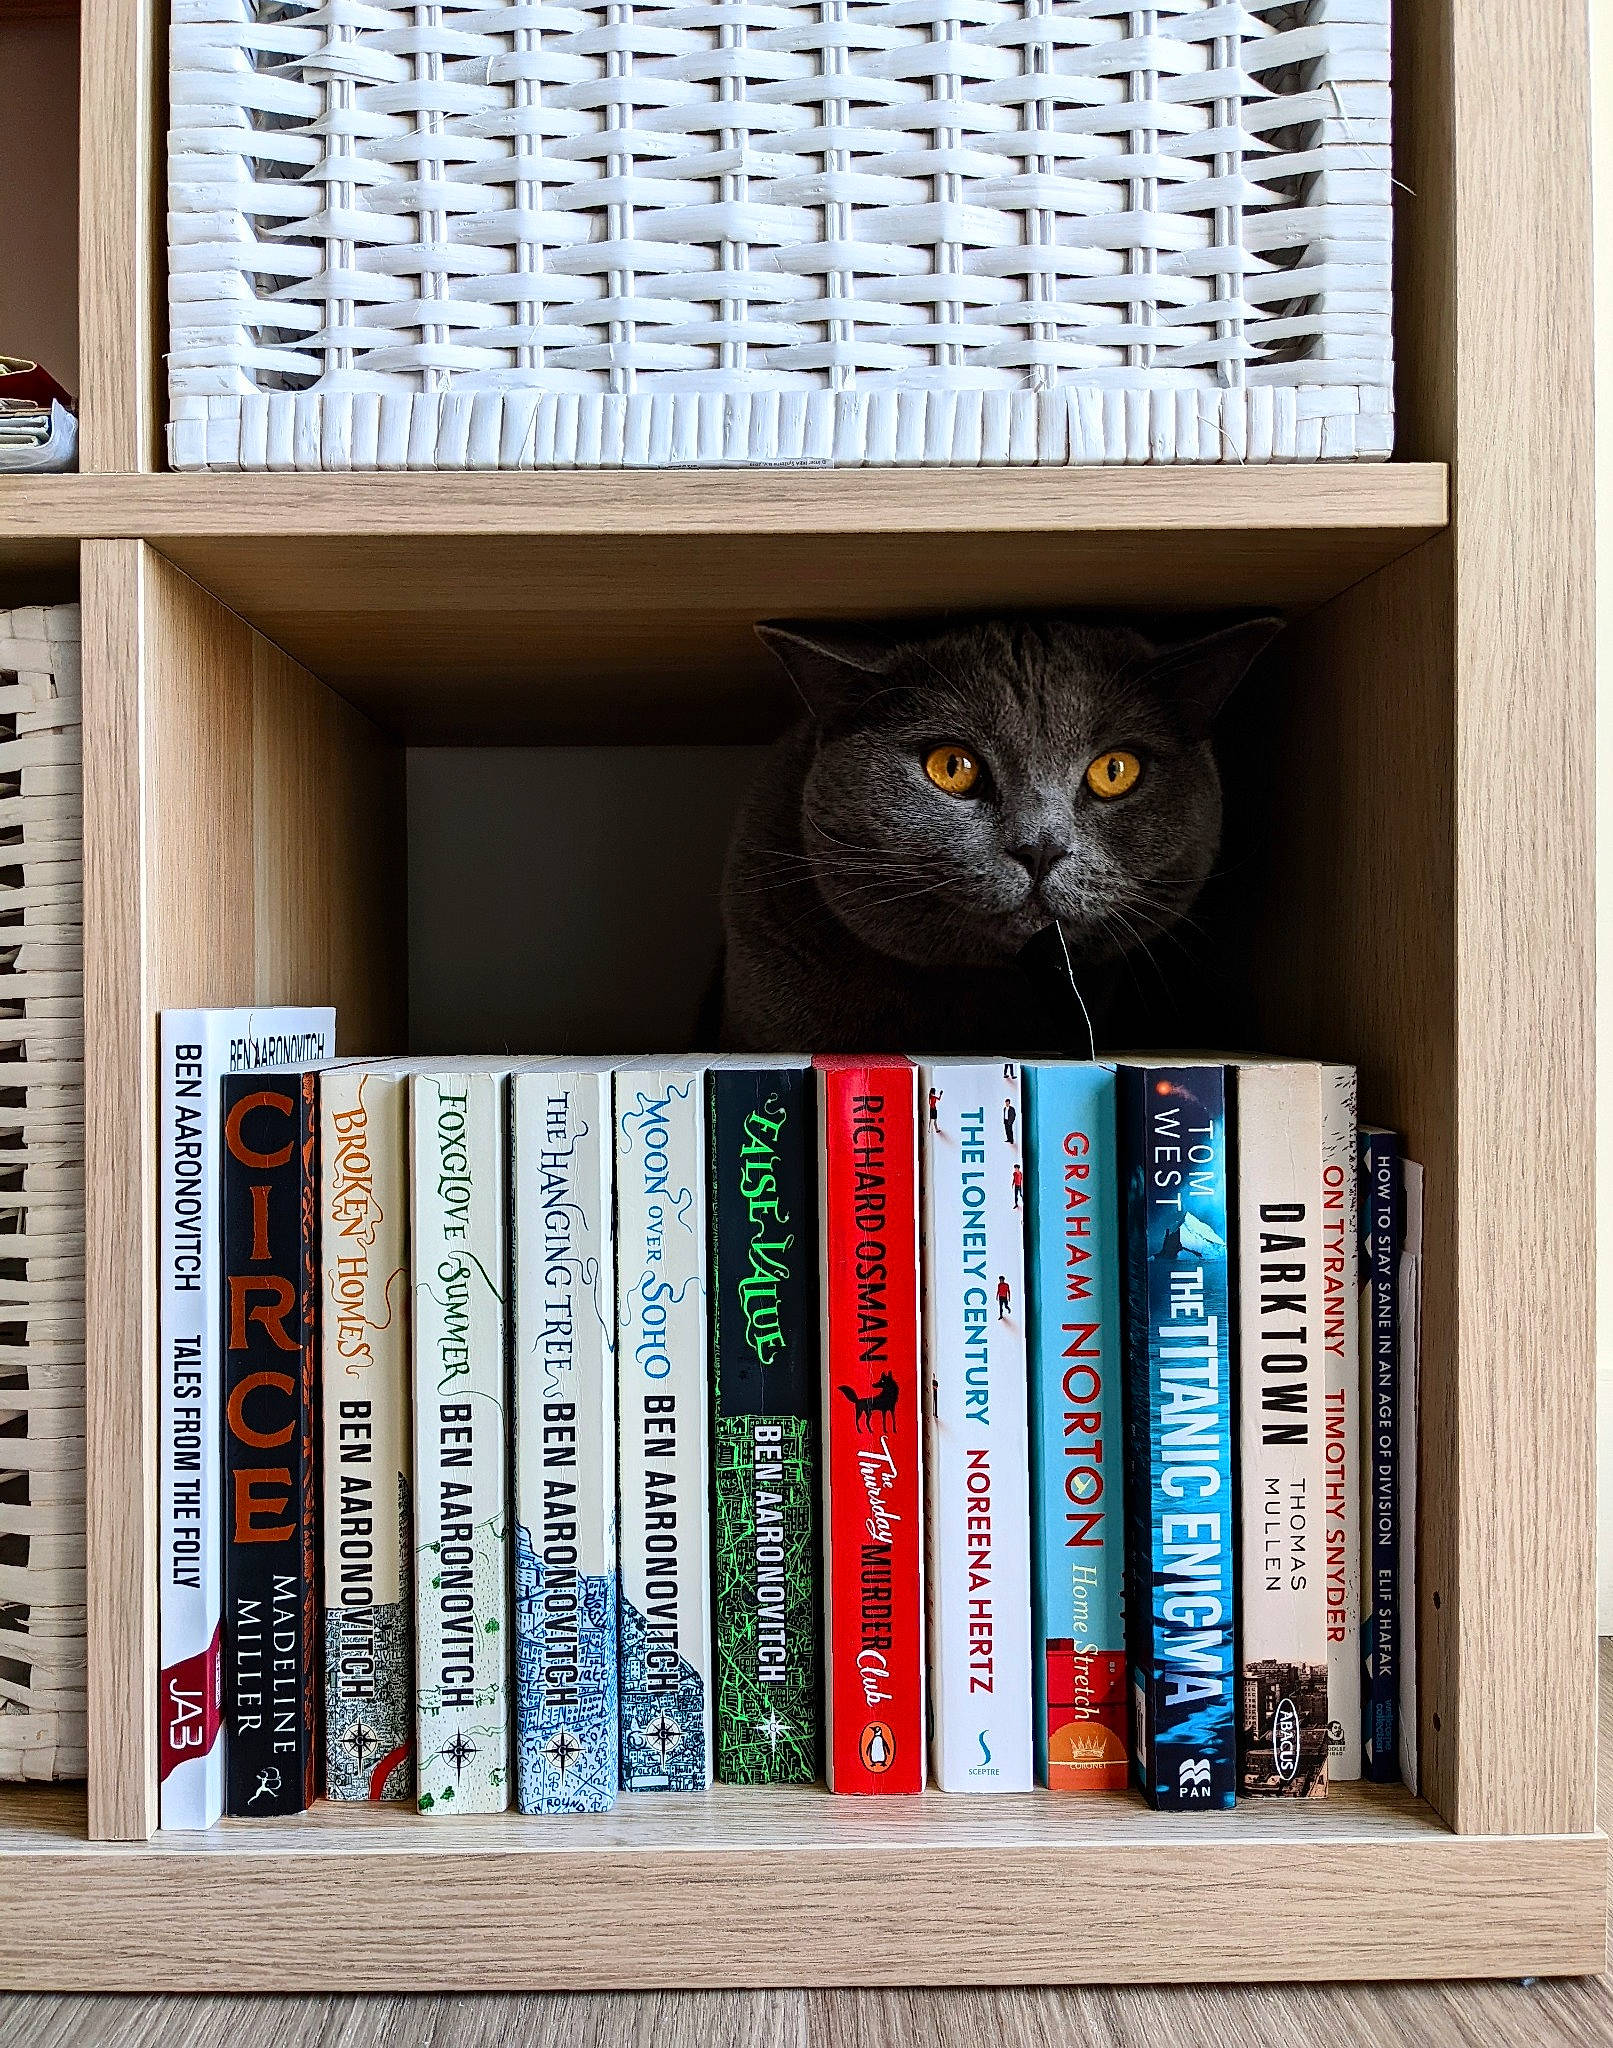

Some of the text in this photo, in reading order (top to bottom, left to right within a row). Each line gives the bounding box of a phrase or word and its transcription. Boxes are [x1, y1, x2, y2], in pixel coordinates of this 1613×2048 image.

[231, 1033, 324, 1069] BEN AARONOVITCH
[1153, 1108, 1182, 1212] WEST
[1187, 1120, 1214, 1197] TOM
[174, 1044, 202, 1292] BEN AARONOVITCH
[330, 1106, 376, 1360] BROKEN HOMES
[437, 1091, 472, 1391] FOXGLOVE SUMMER
[540, 1091, 574, 1371] THE HANGING TREE
[637, 1096, 674, 1380] MOON OVER SOHO
[738, 1108, 794, 1364] FALSE VALUE
[961, 1107, 990, 1426] THE LONELY CENTURY
[1323, 1165, 1345, 1358] ON TYRANNY
[225, 1092, 302, 1543] CIRCE
[854, 1241, 888, 1363] OSMAN
[1060, 1131, 1104, 1548] GRAHAM NORTON
[1258, 1202, 1309, 1446] DARKTOWN
[1377, 1156, 1393, 1546] HOW TO STAY SANE IN AN AGE OF DIVISION
[172, 1334, 202, 1590] TALES FROM THE FOLLY
[543, 1403, 576, 1466] BEN
[644, 1395, 679, 1691] BEN AARONOVITCH
[857, 1452, 901, 1544] Thursday
[1158, 1266, 1223, 1706] THE TITANIC ENIGMA
[1264, 1478, 1281, 1591] MULLEN
[1289, 1478, 1306, 1591] THOMAS
[1324, 1389, 1345, 1643] TIMOTHY SNYDER
[339, 1401, 374, 1700] BEN AARONOVITCH
[439, 1404, 475, 1707] BEN AARONOVITCH
[543, 1481, 578, 1706] AARONOVITCH
[754, 1425, 787, 1682] BEN AARONOVITCH
[860, 1544, 893, 1651] MURDER
[966, 1450, 994, 1696] NOREENA HERTZ
[1071, 1562, 1101, 1721] Home Stretch
[1378, 1569, 1393, 1676] ELIF SHAFAK
[237, 1599, 262, 1734] MILLER
[272, 1575, 296, 1754] MADELINE
[856, 1649, 892, 1707] Club
[968, 1768, 1001, 1777] SCEPTRE
[1279, 1710, 1294, 1771] ABACUS
[1375, 1703, 1384, 1753] collection
[1179, 1786, 1211, 1798] PAN
